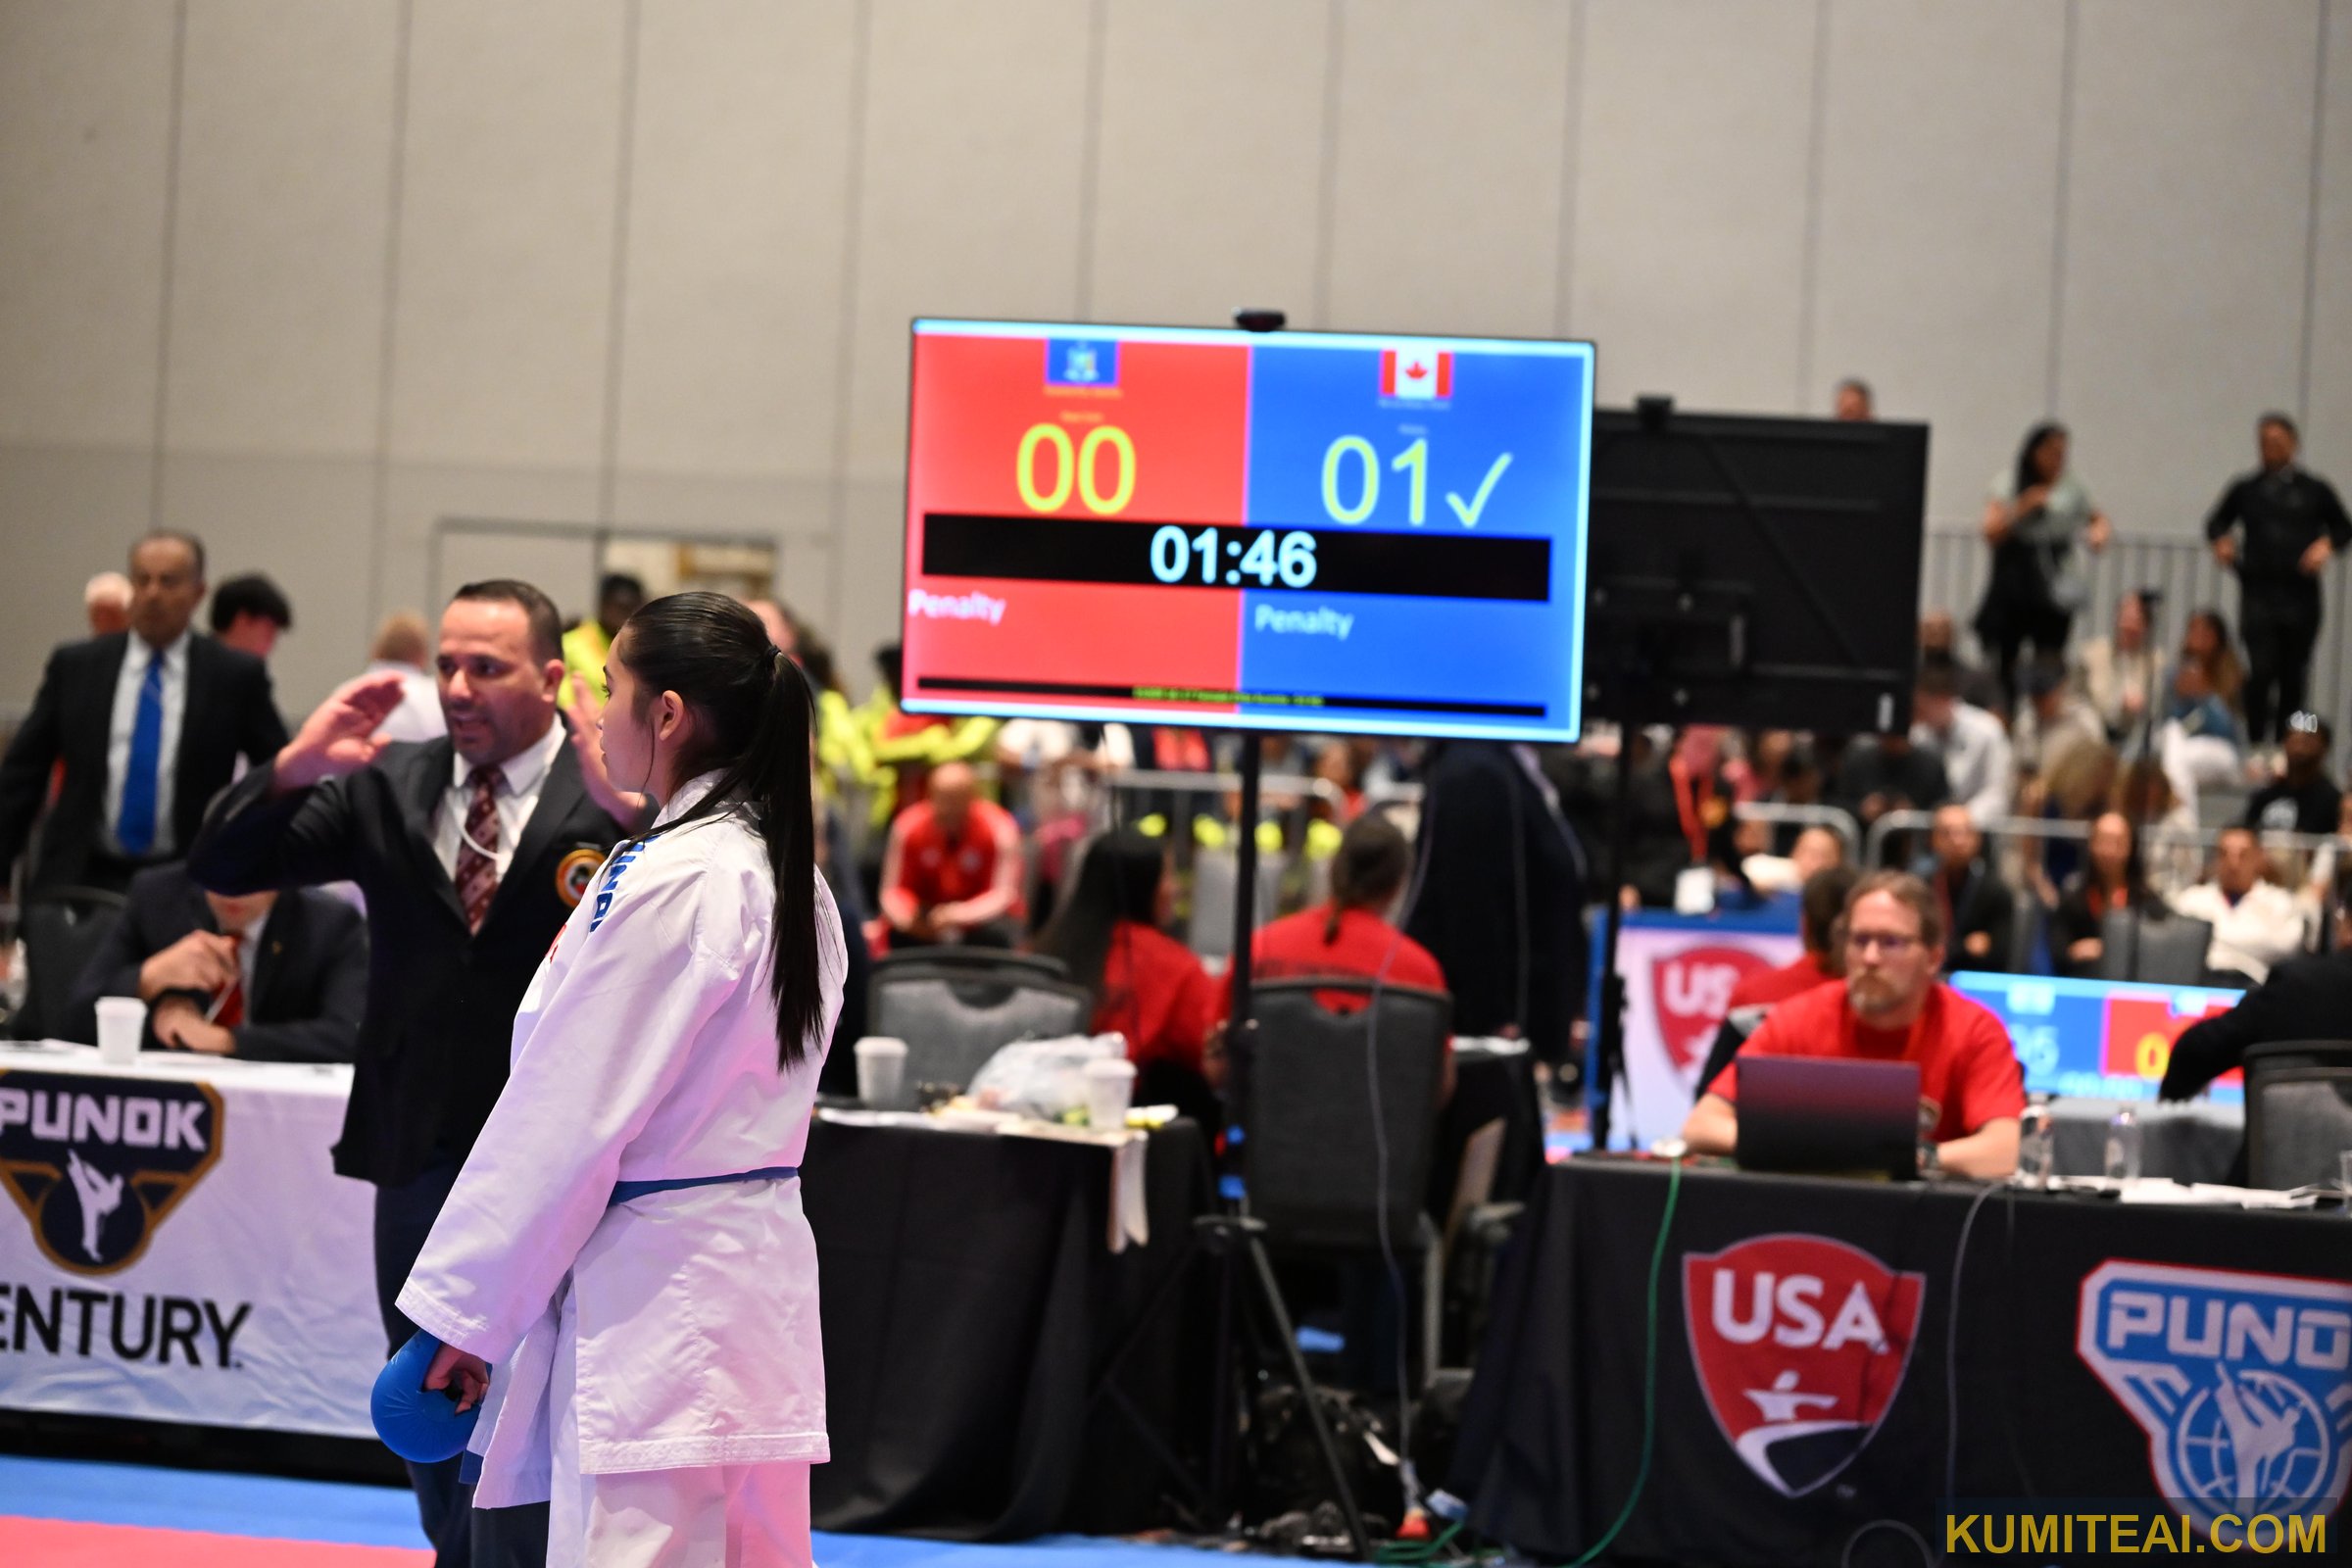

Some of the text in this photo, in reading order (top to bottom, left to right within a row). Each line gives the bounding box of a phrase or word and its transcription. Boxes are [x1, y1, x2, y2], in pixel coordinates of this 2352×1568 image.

[1017, 424, 1136, 514] 00
[1322, 435, 1428, 525] 01
[1150, 525, 1318, 588] 01:46
[908, 589, 1005, 626] Penalty
[1254, 604, 1354, 640] Penalty
[0, 1087, 207, 1152] PUNOK
[1712, 1269, 1890, 1355] USA
